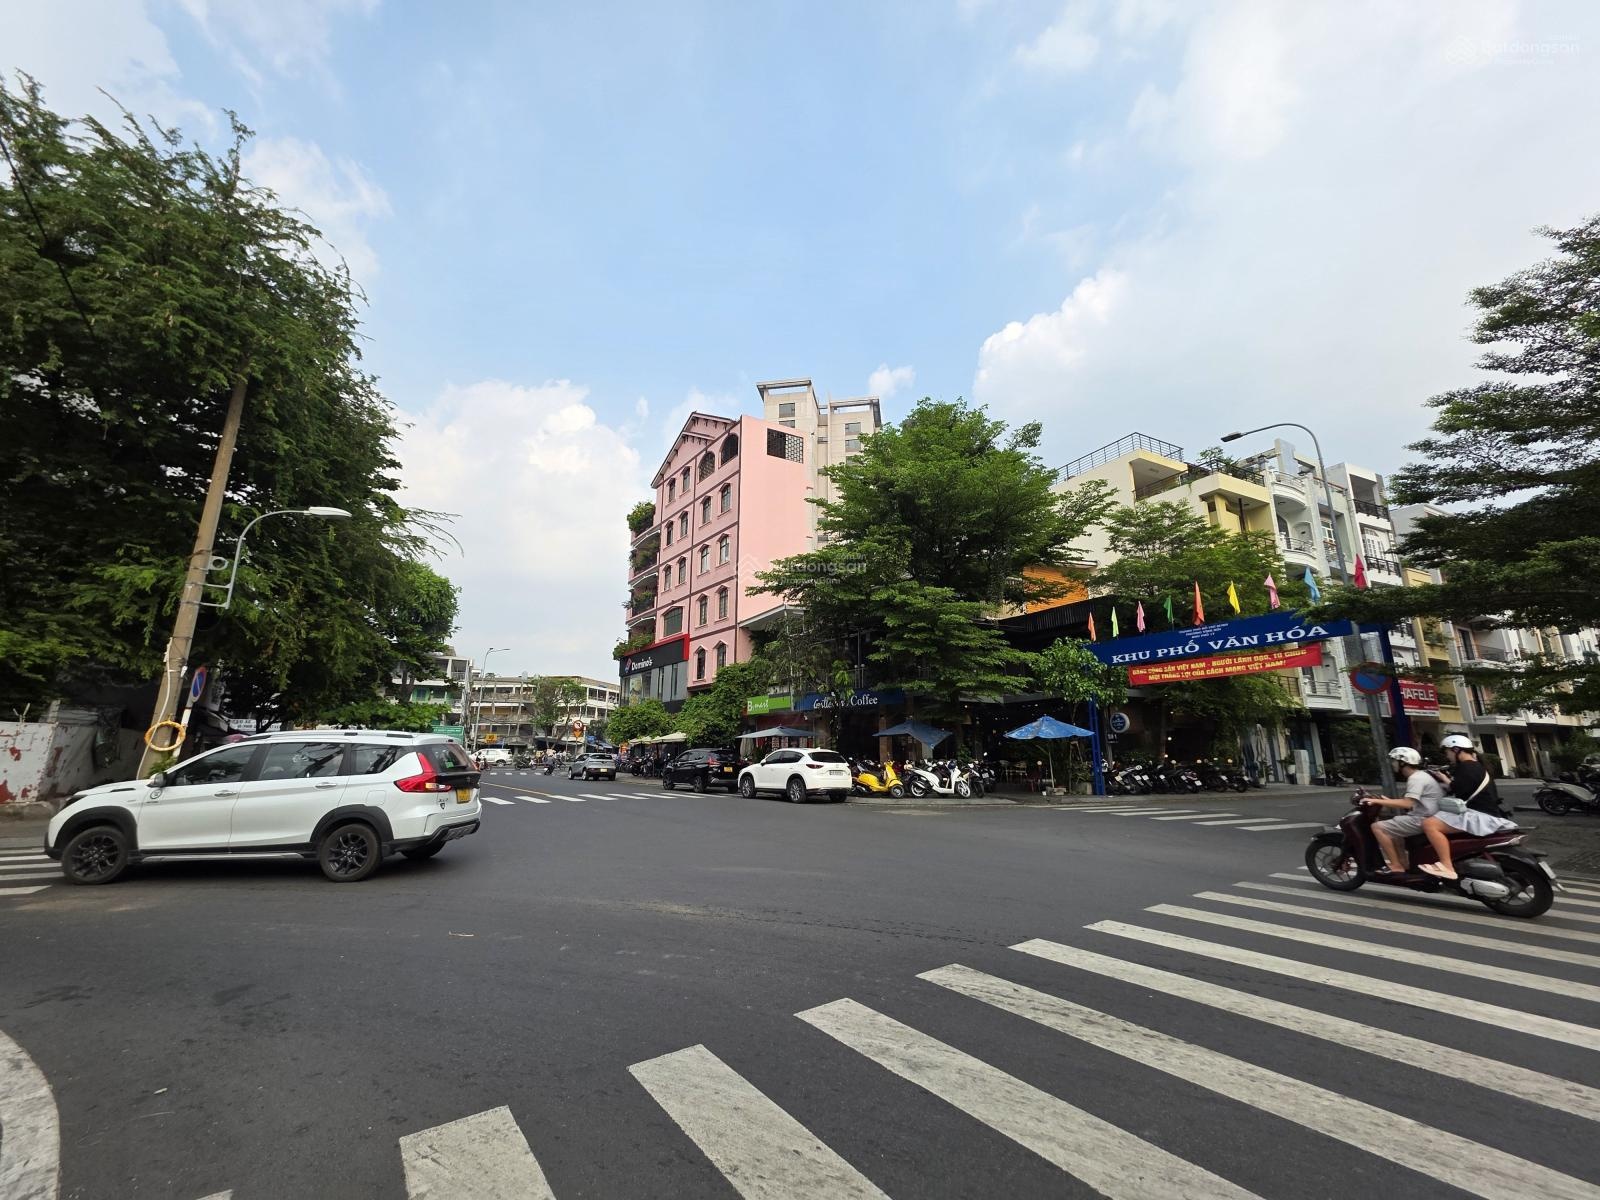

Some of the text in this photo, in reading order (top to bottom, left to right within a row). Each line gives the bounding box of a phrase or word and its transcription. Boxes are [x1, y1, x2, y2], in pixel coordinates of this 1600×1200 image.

[1111, 625, 1329, 663] KHU PHỐ VĂN HÓA
[631, 656, 653, 671] Domino's
[1176, 663, 1189, 671] VIỆT
[850, 693, 878, 706] Coffee
